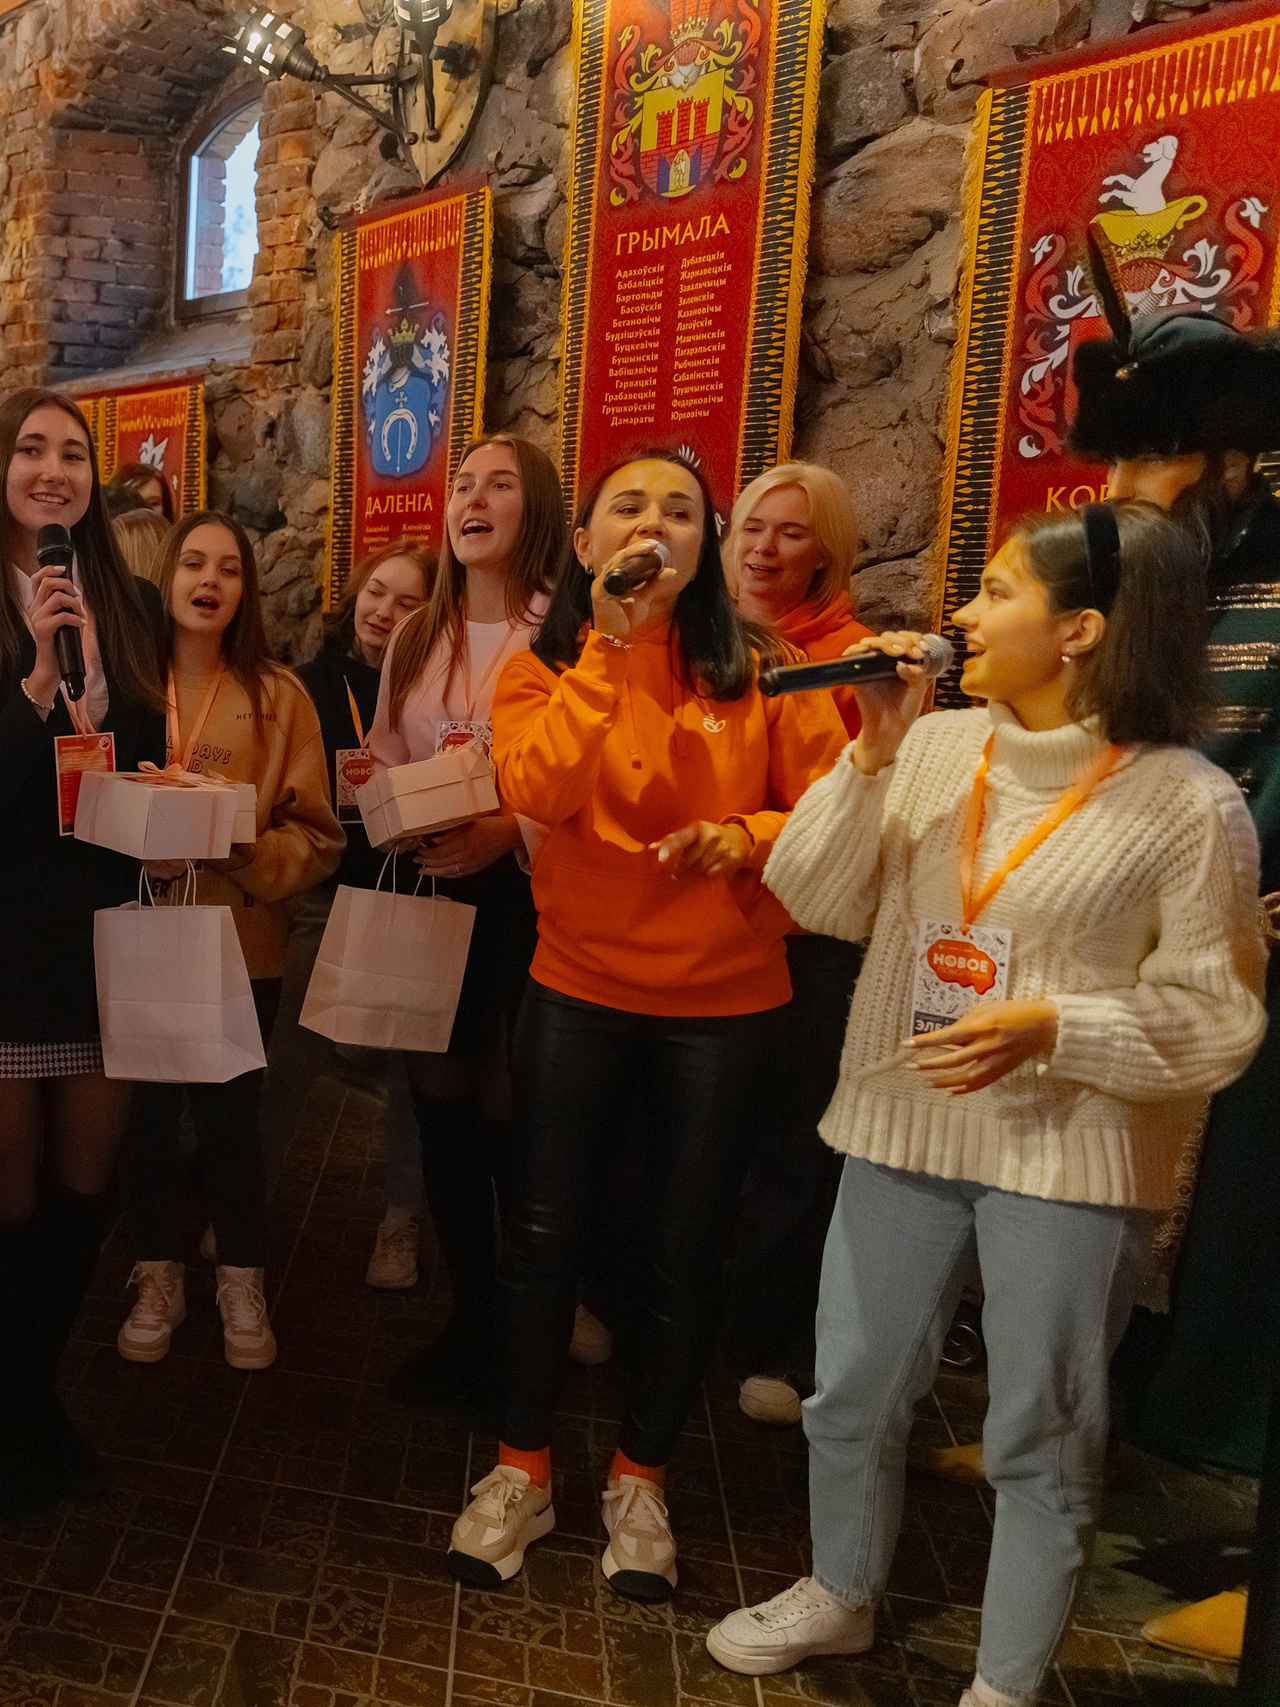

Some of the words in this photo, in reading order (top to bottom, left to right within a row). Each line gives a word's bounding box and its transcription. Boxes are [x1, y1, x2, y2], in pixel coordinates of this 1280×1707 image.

[616, 212, 730, 256] ГРЫМАЛА
[615, 263, 665, 279] Адахоўскія
[617, 276, 664, 291] Бабаліцкія
[616, 290, 663, 303] Бартольды
[620, 302, 662, 315] Басоўскія
[677, 304, 722, 319] Казановічы
[612, 315, 661, 328] Бегановічы
[676, 317, 713, 332] Лагоўскія
[614, 340, 660, 353] Буцкевічы
[612, 352, 659, 366] Бушынскія
[602, 402, 655, 415] Грушкоўскія
[671, 409, 710, 421] Юрковічы
[610, 416, 655, 427] Дамараты
[365, 493, 433, 518] ДАЛЕНГА
[346, 767, 373, 776] НОВО
[933, 952, 989, 973] НОВОЕ
